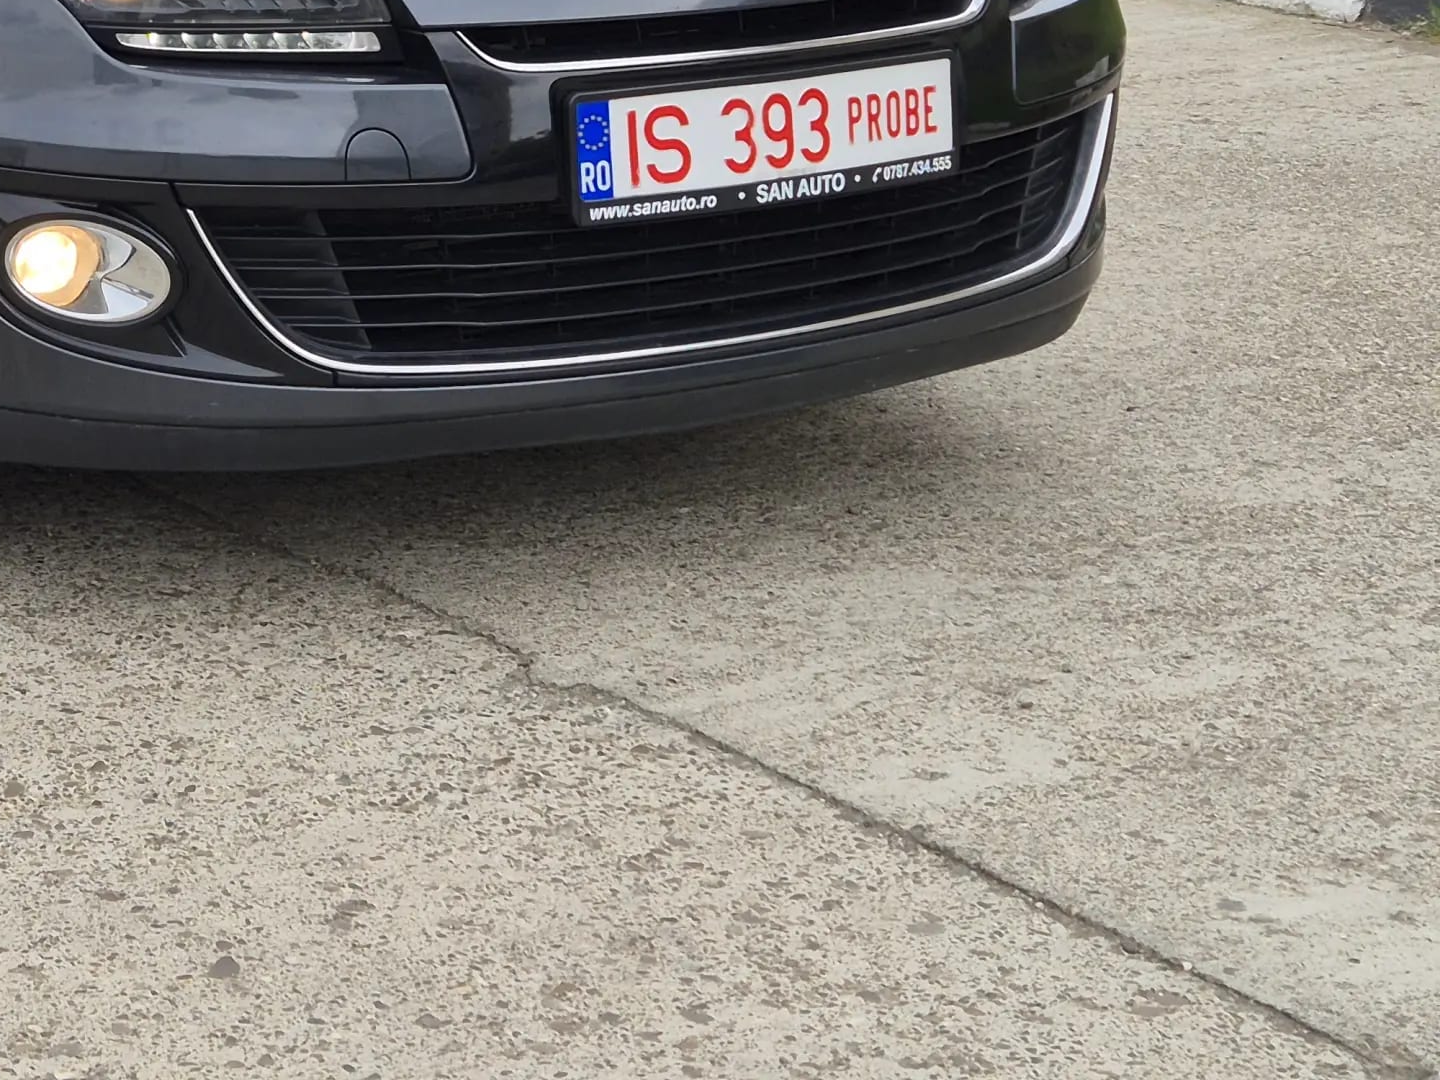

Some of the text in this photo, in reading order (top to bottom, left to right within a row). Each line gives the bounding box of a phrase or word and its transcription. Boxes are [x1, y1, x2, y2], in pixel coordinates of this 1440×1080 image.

[626, 85, 938, 189] IS 393 PROBE
[580, 160, 611, 194] RO
[589, 193, 718, 221] www.sanauto.ro
[755, 181, 796, 205] SAN
[798, 172, 846, 199] AUTO
